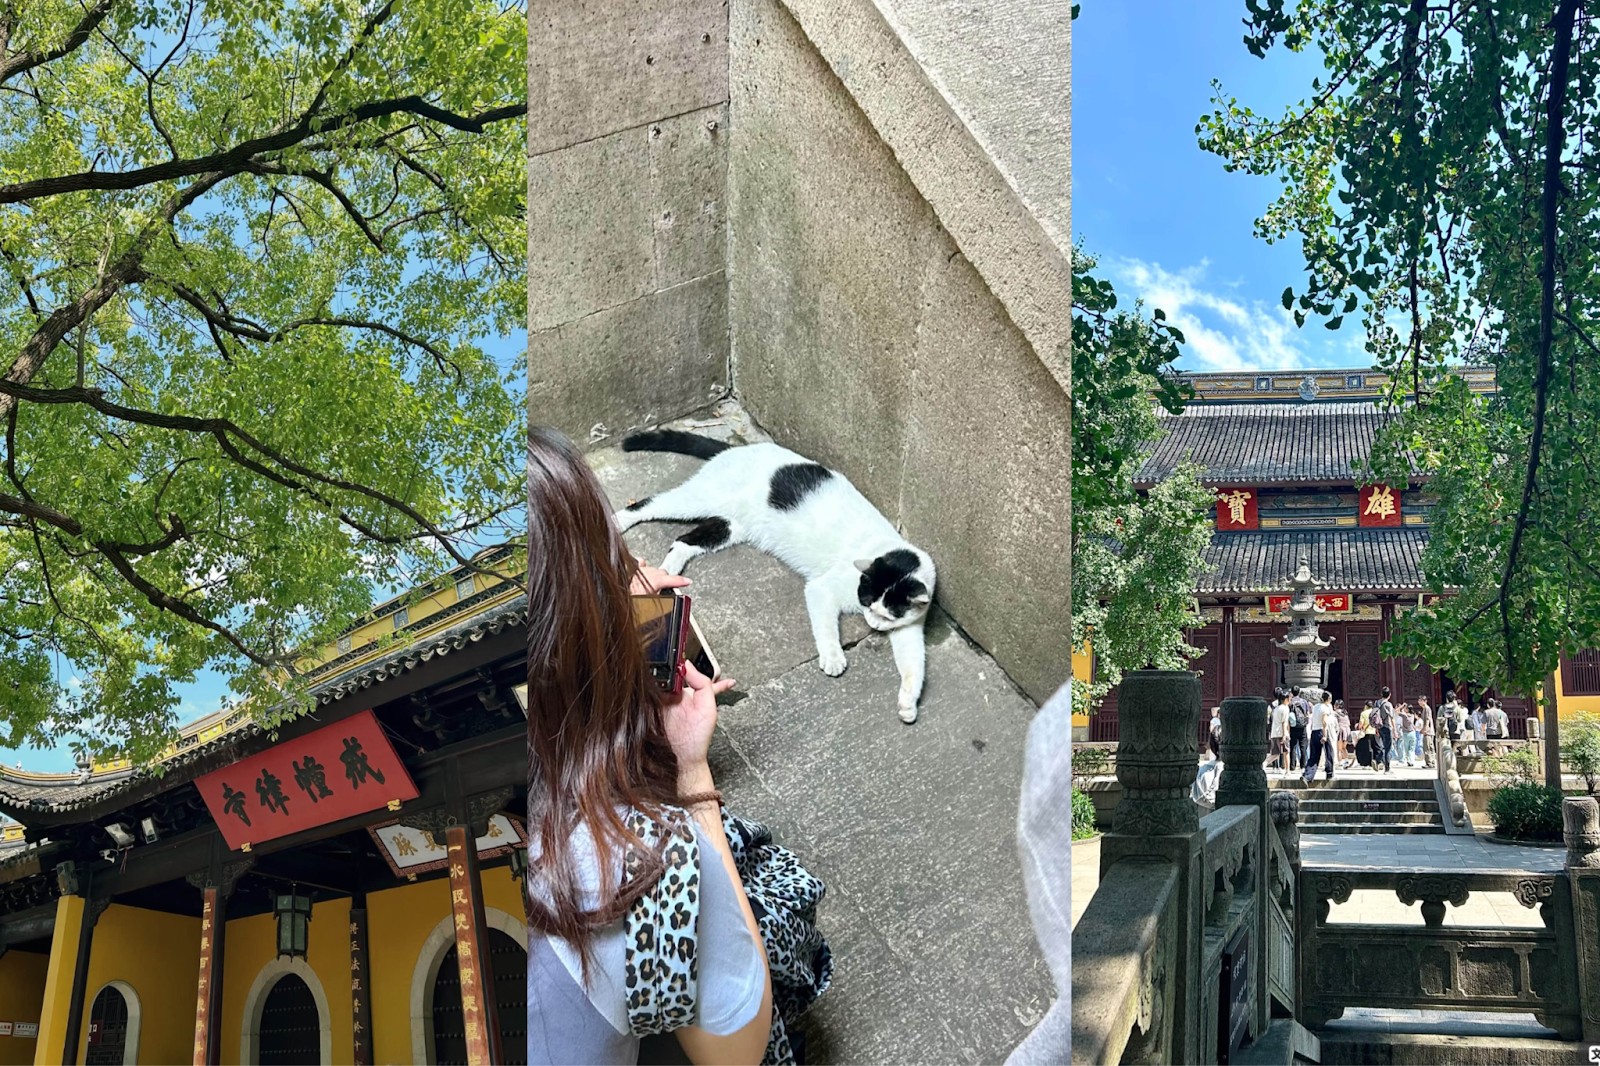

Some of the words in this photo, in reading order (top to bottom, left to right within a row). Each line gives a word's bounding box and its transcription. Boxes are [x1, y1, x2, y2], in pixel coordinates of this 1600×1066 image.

[1224, 489, 1252, 525] 寶
[1364, 485, 1396, 520] 雄
[222, 736, 385, 828] 戒幢律寺
